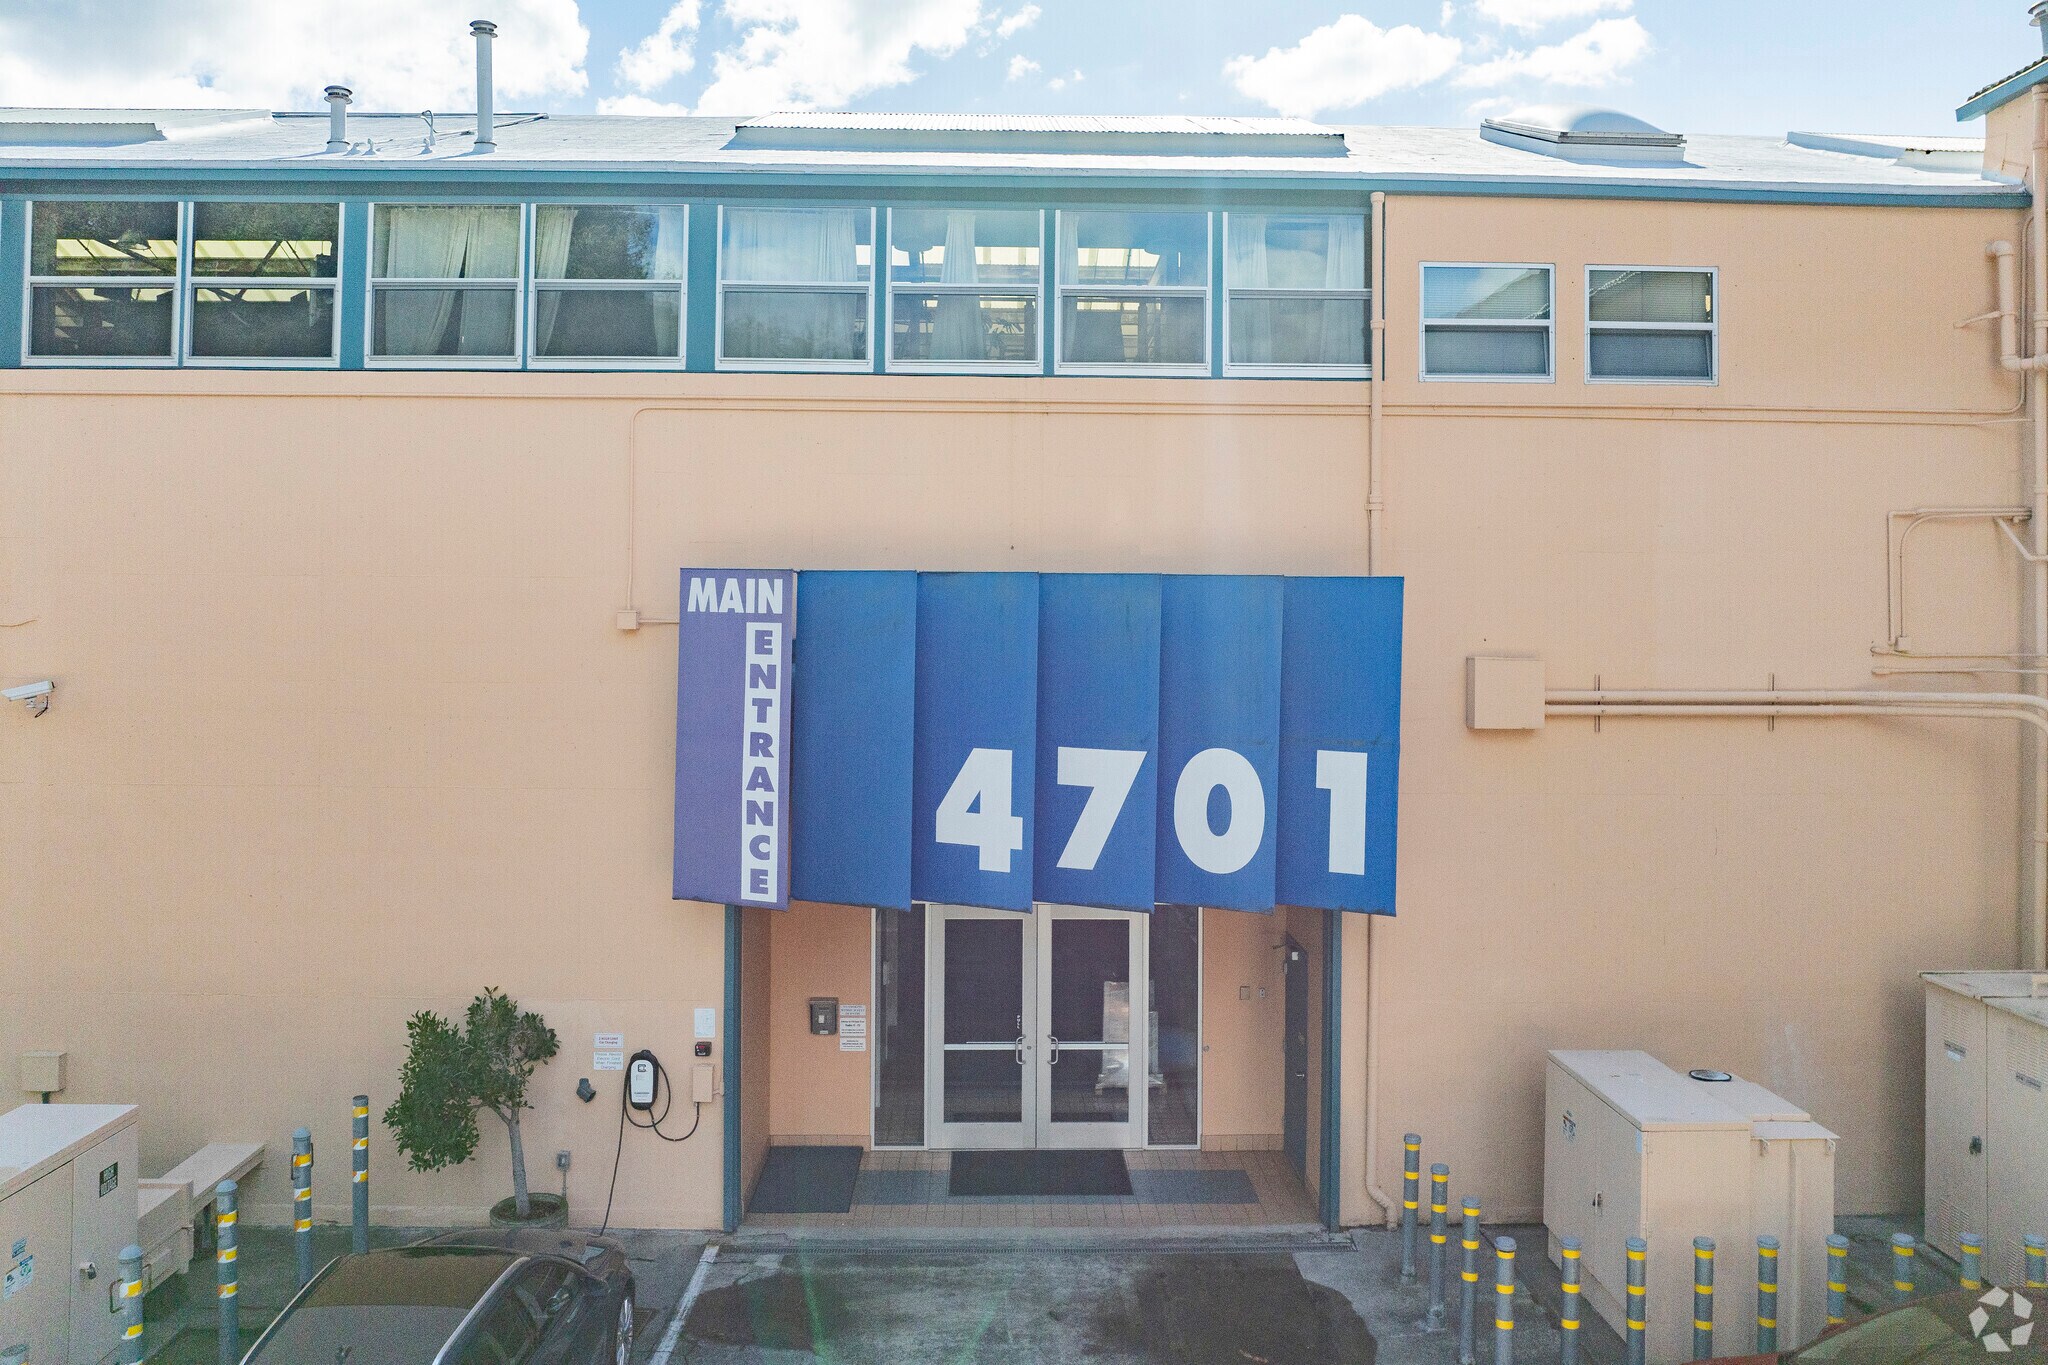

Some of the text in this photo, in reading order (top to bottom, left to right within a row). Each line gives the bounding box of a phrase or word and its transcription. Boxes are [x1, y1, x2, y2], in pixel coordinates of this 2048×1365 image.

[687, 577, 783, 614] MAIN
[746, 629, 777, 896] ENTRANCE
[936, 746, 1368, 876] 4701
